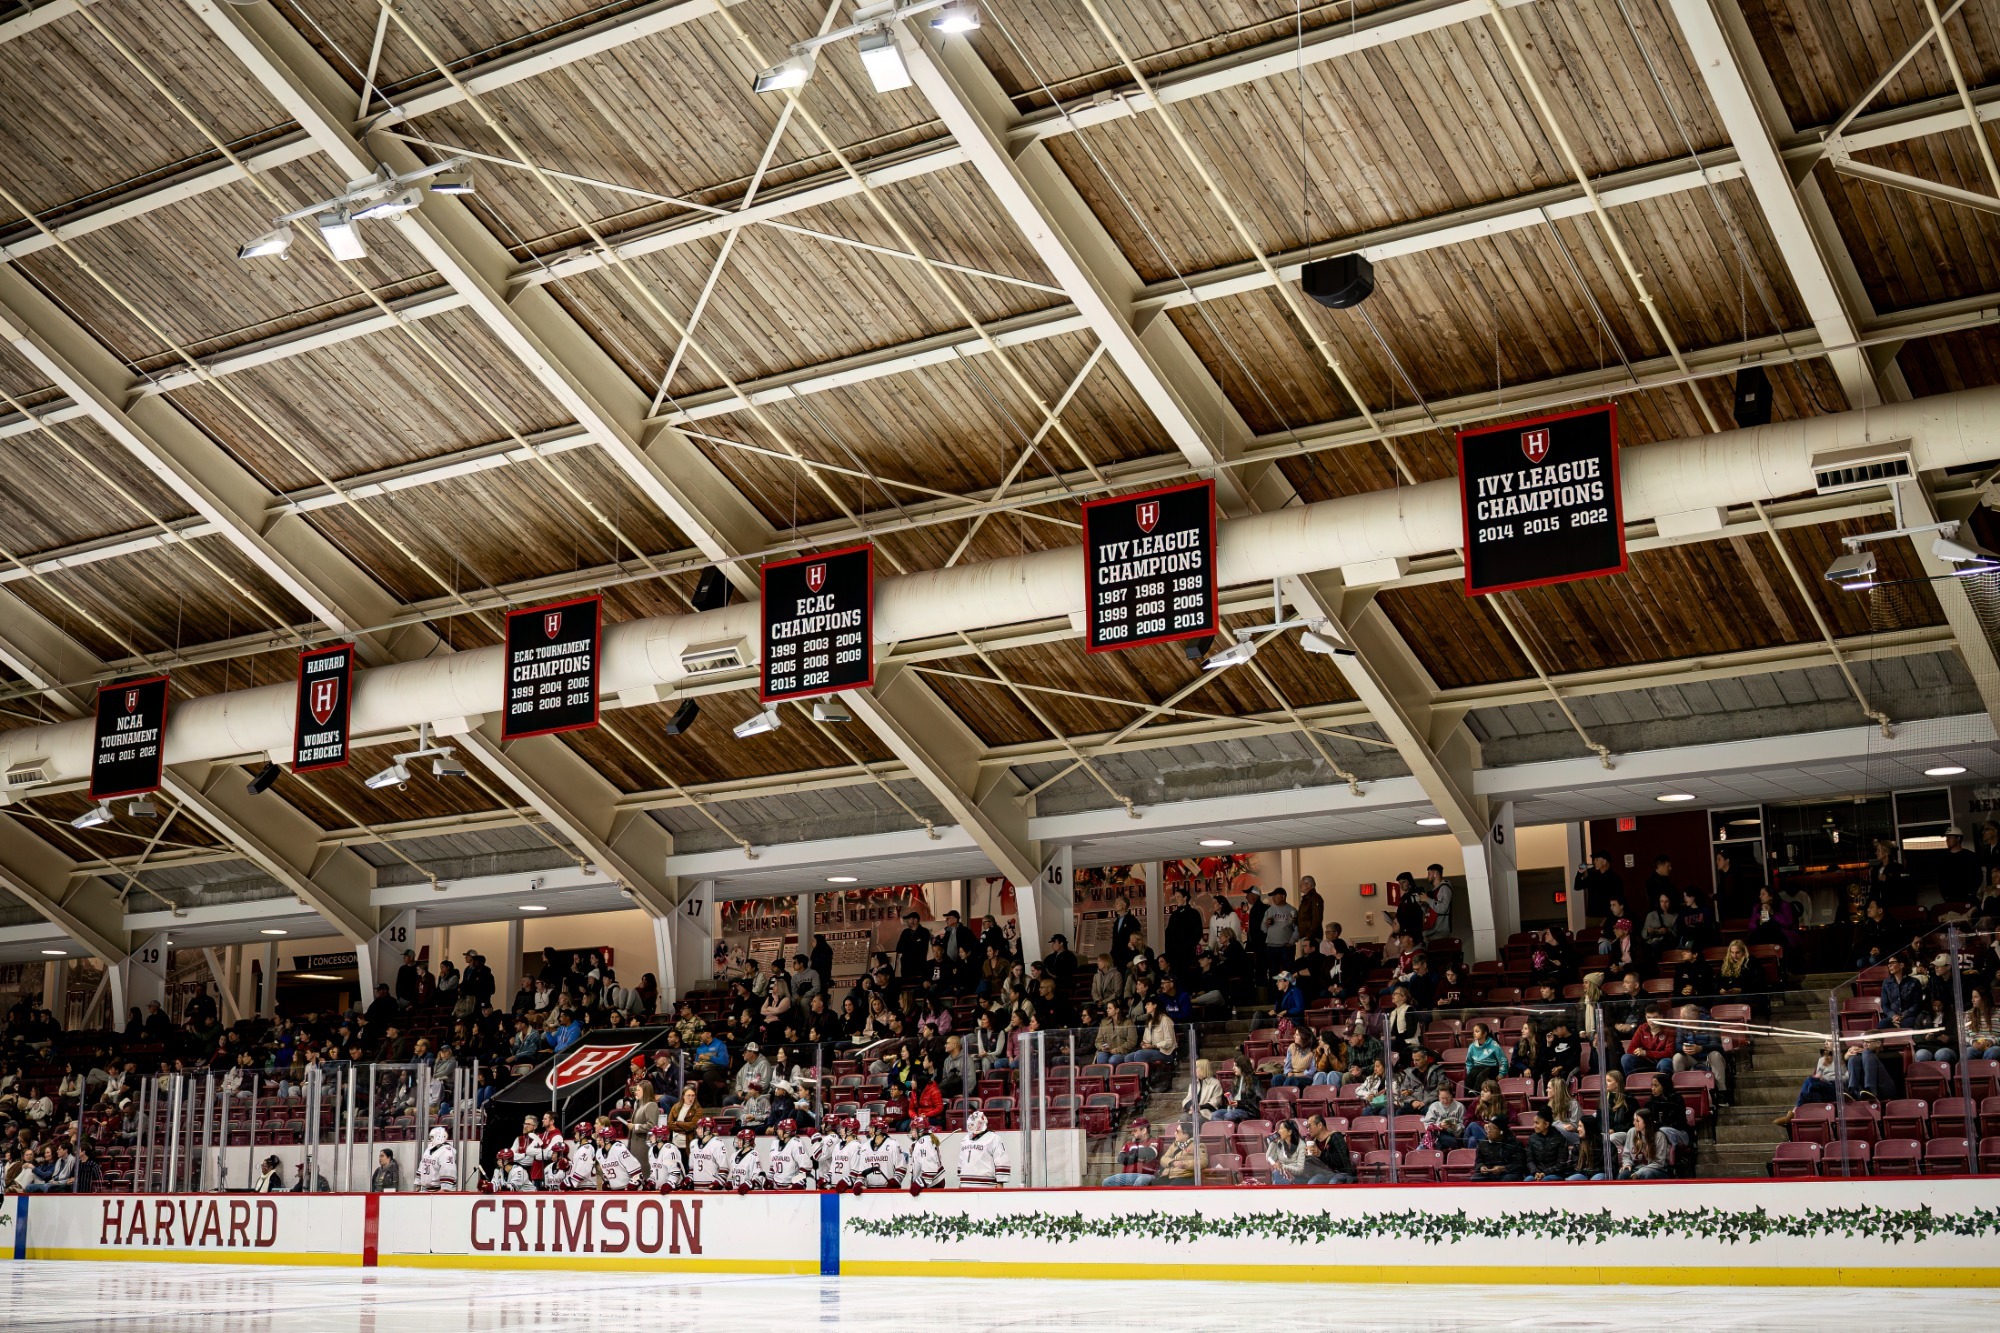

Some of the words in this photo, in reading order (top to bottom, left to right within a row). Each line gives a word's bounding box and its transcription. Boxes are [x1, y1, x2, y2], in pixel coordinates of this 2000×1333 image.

[1528, 433, 1544, 455] H
[1477, 472, 1514, 498] IVY
[1517, 457, 1600, 490] LEAGUE
[1477, 481, 1604, 521] CHAMPIONS
[1141, 505, 1154, 525] H
[1478, 524, 1514, 543] 2014
[1523, 516, 1560, 535] 2015
[1570, 508, 1608, 527] 2022
[1099, 541, 1130, 564] IVY
[1132, 528, 1200, 558] LEAGUE
[810, 566, 821, 585] H
[1098, 550, 1202, 585] CHAMPIONS
[1098, 588, 1127, 605] 1987
[1135, 582, 1165, 599] 1988
[1172, 575, 1202, 592] 1989
[796, 593, 835, 616] ECAC
[1098, 606, 1128, 624] 1999
[1135, 600, 1165, 617] 2003
[1173, 593, 1203, 611] 2005
[548, 615, 558, 633] H
[771, 609, 861, 640] CHAMPIONS
[1098, 624, 1128, 641] 2008
[1136, 618, 1166, 635] 2009
[1174, 612, 1204, 629] 2013
[514, 649, 534, 664] ECAC
[536, 639, 591, 660] TOURNAMENT
[770, 643, 796, 658] 1999
[803, 637, 829, 652] 2003
[836, 632, 862, 648] 2004
[306, 655, 345, 674] HARVARD
[513, 655, 590, 683] CHAMPIONS
[770, 660, 796, 675] 2005
[803, 654, 829, 669] 2008
[836, 648, 861, 664] 2009
[511, 685, 534, 699] 1999
[539, 681, 562, 695] 2004
[567, 676, 590, 690] 2005
[770, 676, 796, 691] 2015
[803, 671, 829, 686] 2022
[127, 692, 137, 707] H
[316, 683, 332, 712] H
[511, 701, 533, 715] 2006
[539, 697, 561, 711] 2008
[567, 692, 589, 706] 2015
[117, 714, 143, 731] NCAA
[101, 728, 158, 748] TOURNAMENT
[303, 730, 340, 747] WOMEN'S
[98, 752, 115, 765] 2014
[118, 749, 136, 762] 2015
[139, 745, 157, 758] 2022
[299, 750, 312, 763] ICE
[312, 744, 342, 760] HOCKEY
[1048, 866, 1062, 885] 16
[687, 899, 702, 916] 17
[738, 914, 796, 931] CRIMSON
[850, 905, 902, 921] HOCKEY
[390, 926, 406, 942] 18
[142, 949, 159, 963] 19
[559, 1051, 621, 1078] H
[100, 1199, 278, 1247] HARVARD
[470, 1199, 703, 1255] CRIMSON
